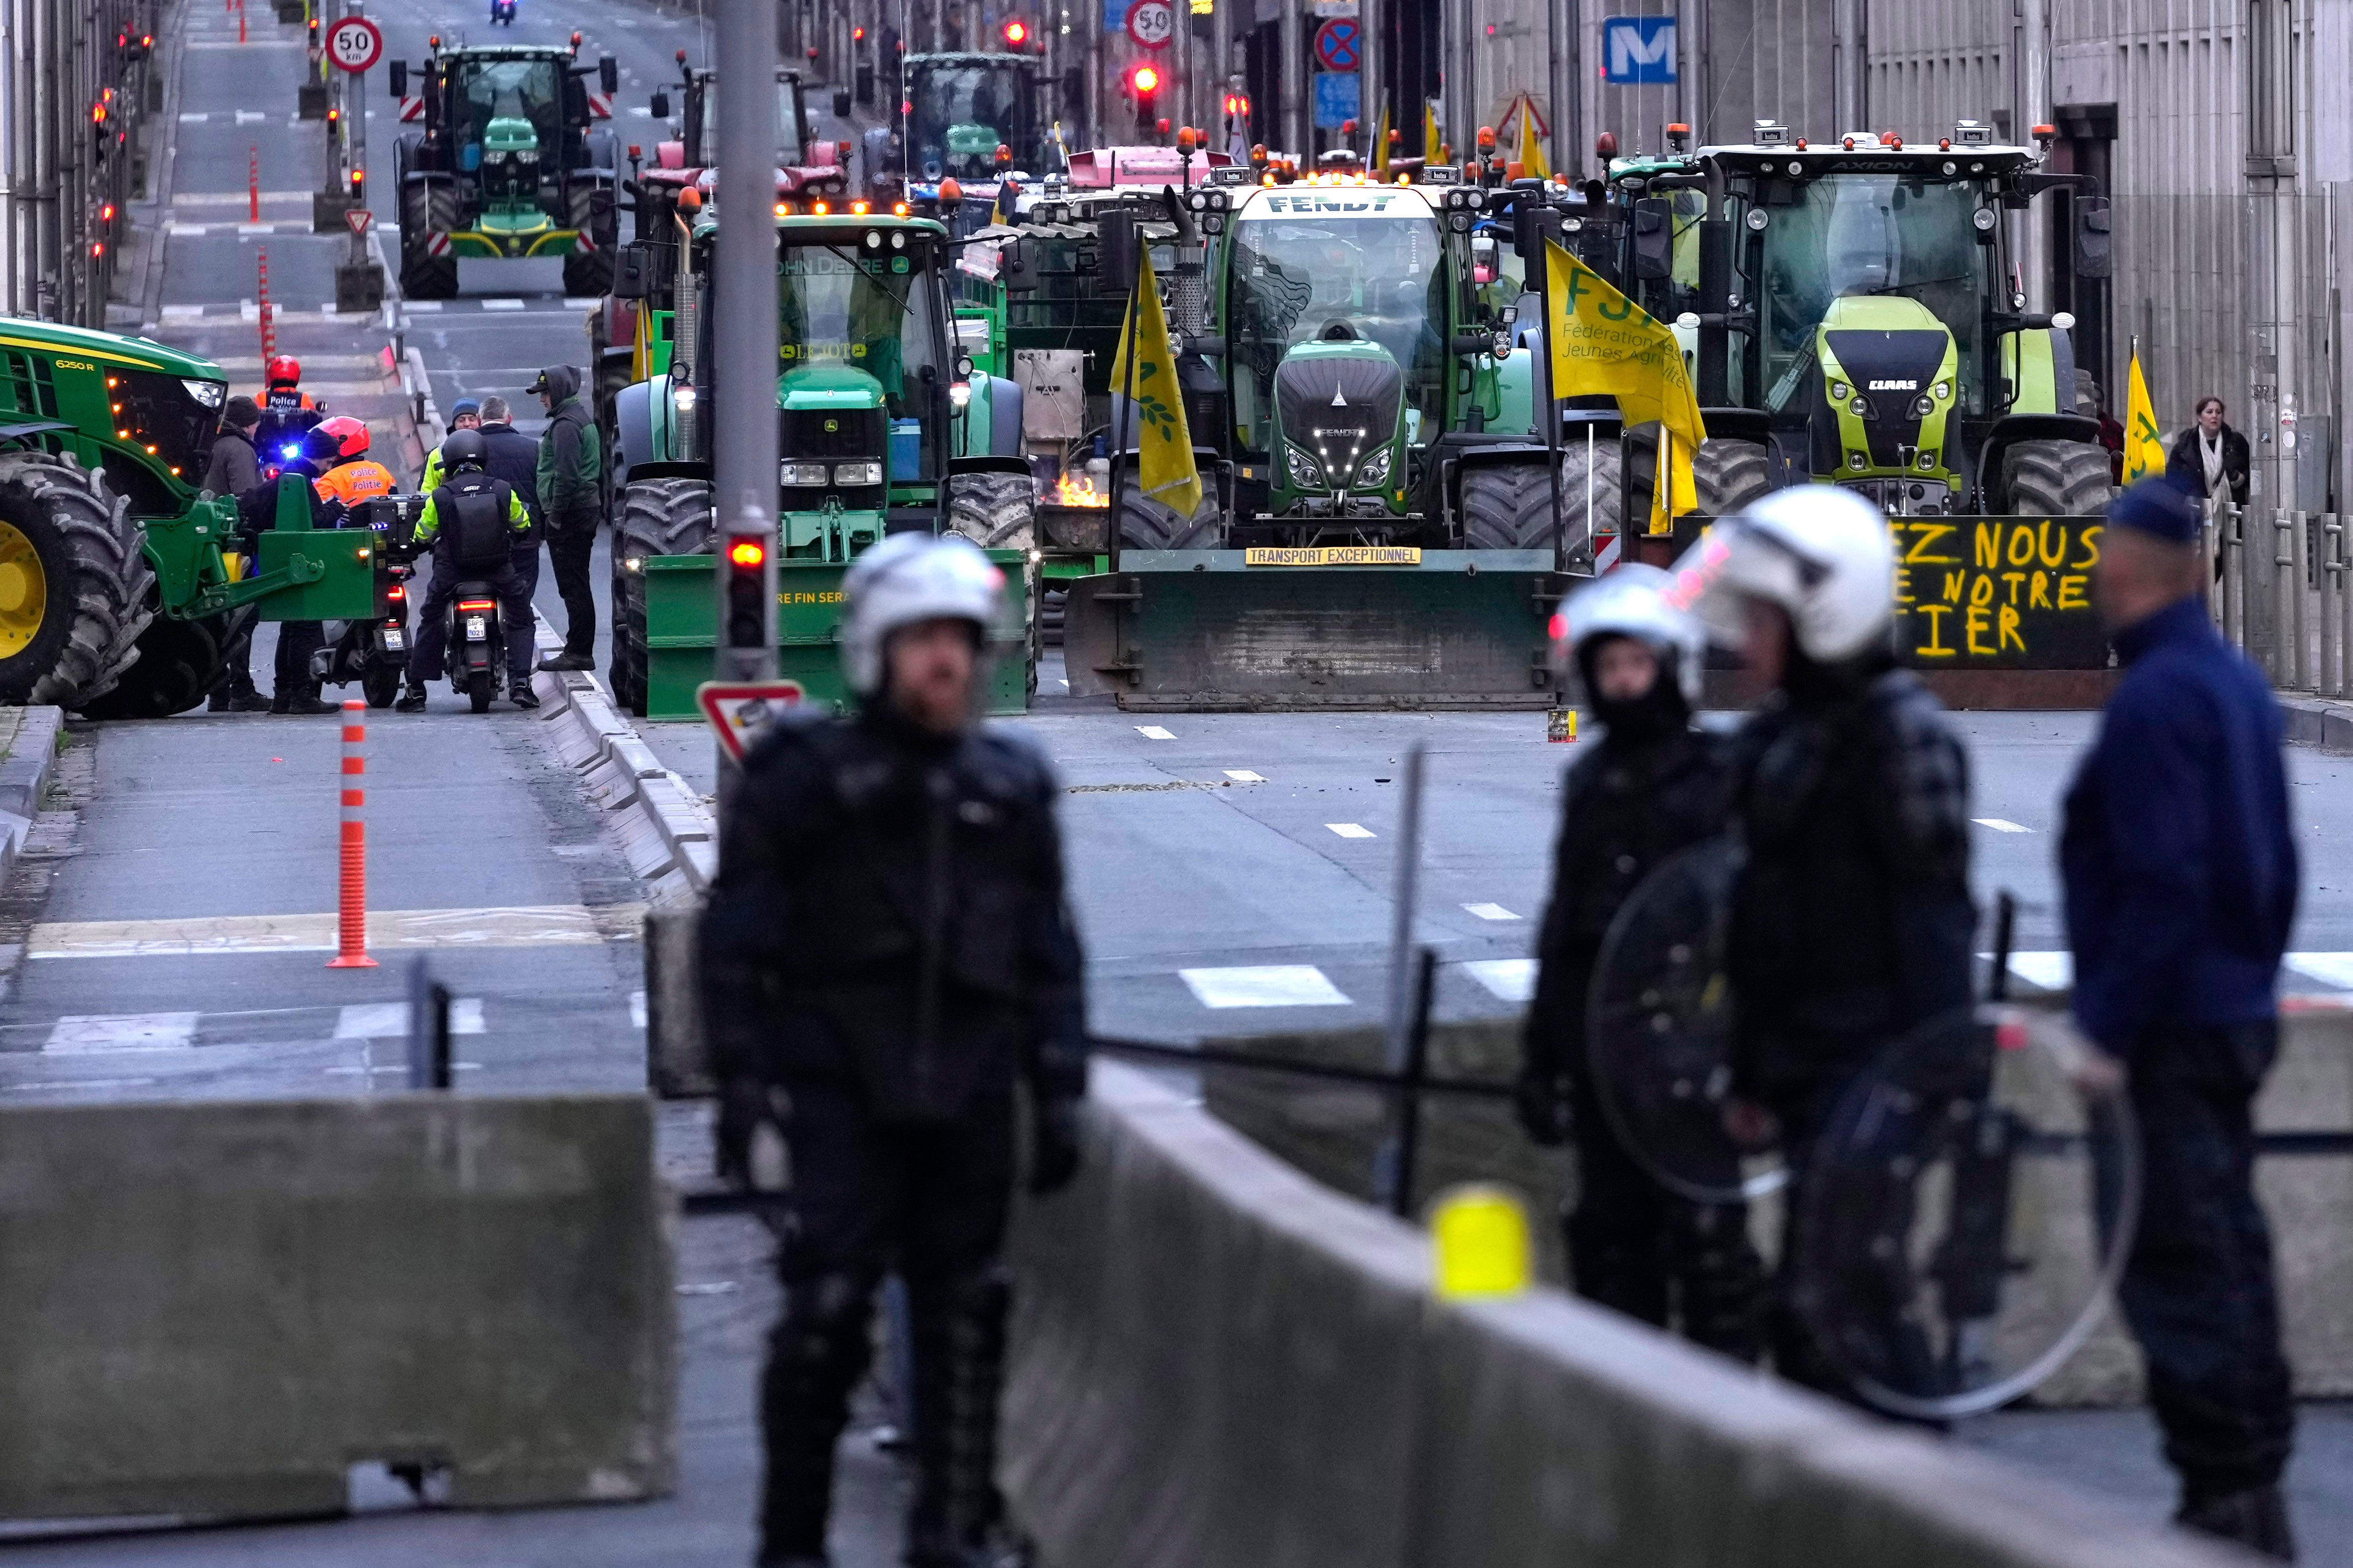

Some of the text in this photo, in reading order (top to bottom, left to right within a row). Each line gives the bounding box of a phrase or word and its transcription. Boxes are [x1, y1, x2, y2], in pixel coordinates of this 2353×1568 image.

[1139, 10, 1168, 30] 50
[339, 32, 368, 50] 50
[1266, 195, 1396, 212] FENDT
[1563, 322, 1653, 348] Fédération
[1562, 343, 1622, 360] Jeunes
[55, 359, 95, 371] 6250 R
[1868, 380, 1917, 390] CLAAS
[270, 396, 297, 407] Police
[350, 467, 377, 477] Police
[353, 480, 382, 491] Politie
[1887, 520, 2105, 569] EZ NOUS
[1250, 548, 1417, 563] TRANSPORT EXCEPTIONNEL
[795, 592, 815, 603] FIN
[1943, 568, 2089, 610] NOTRE
[1894, 603, 2026, 656] IER
